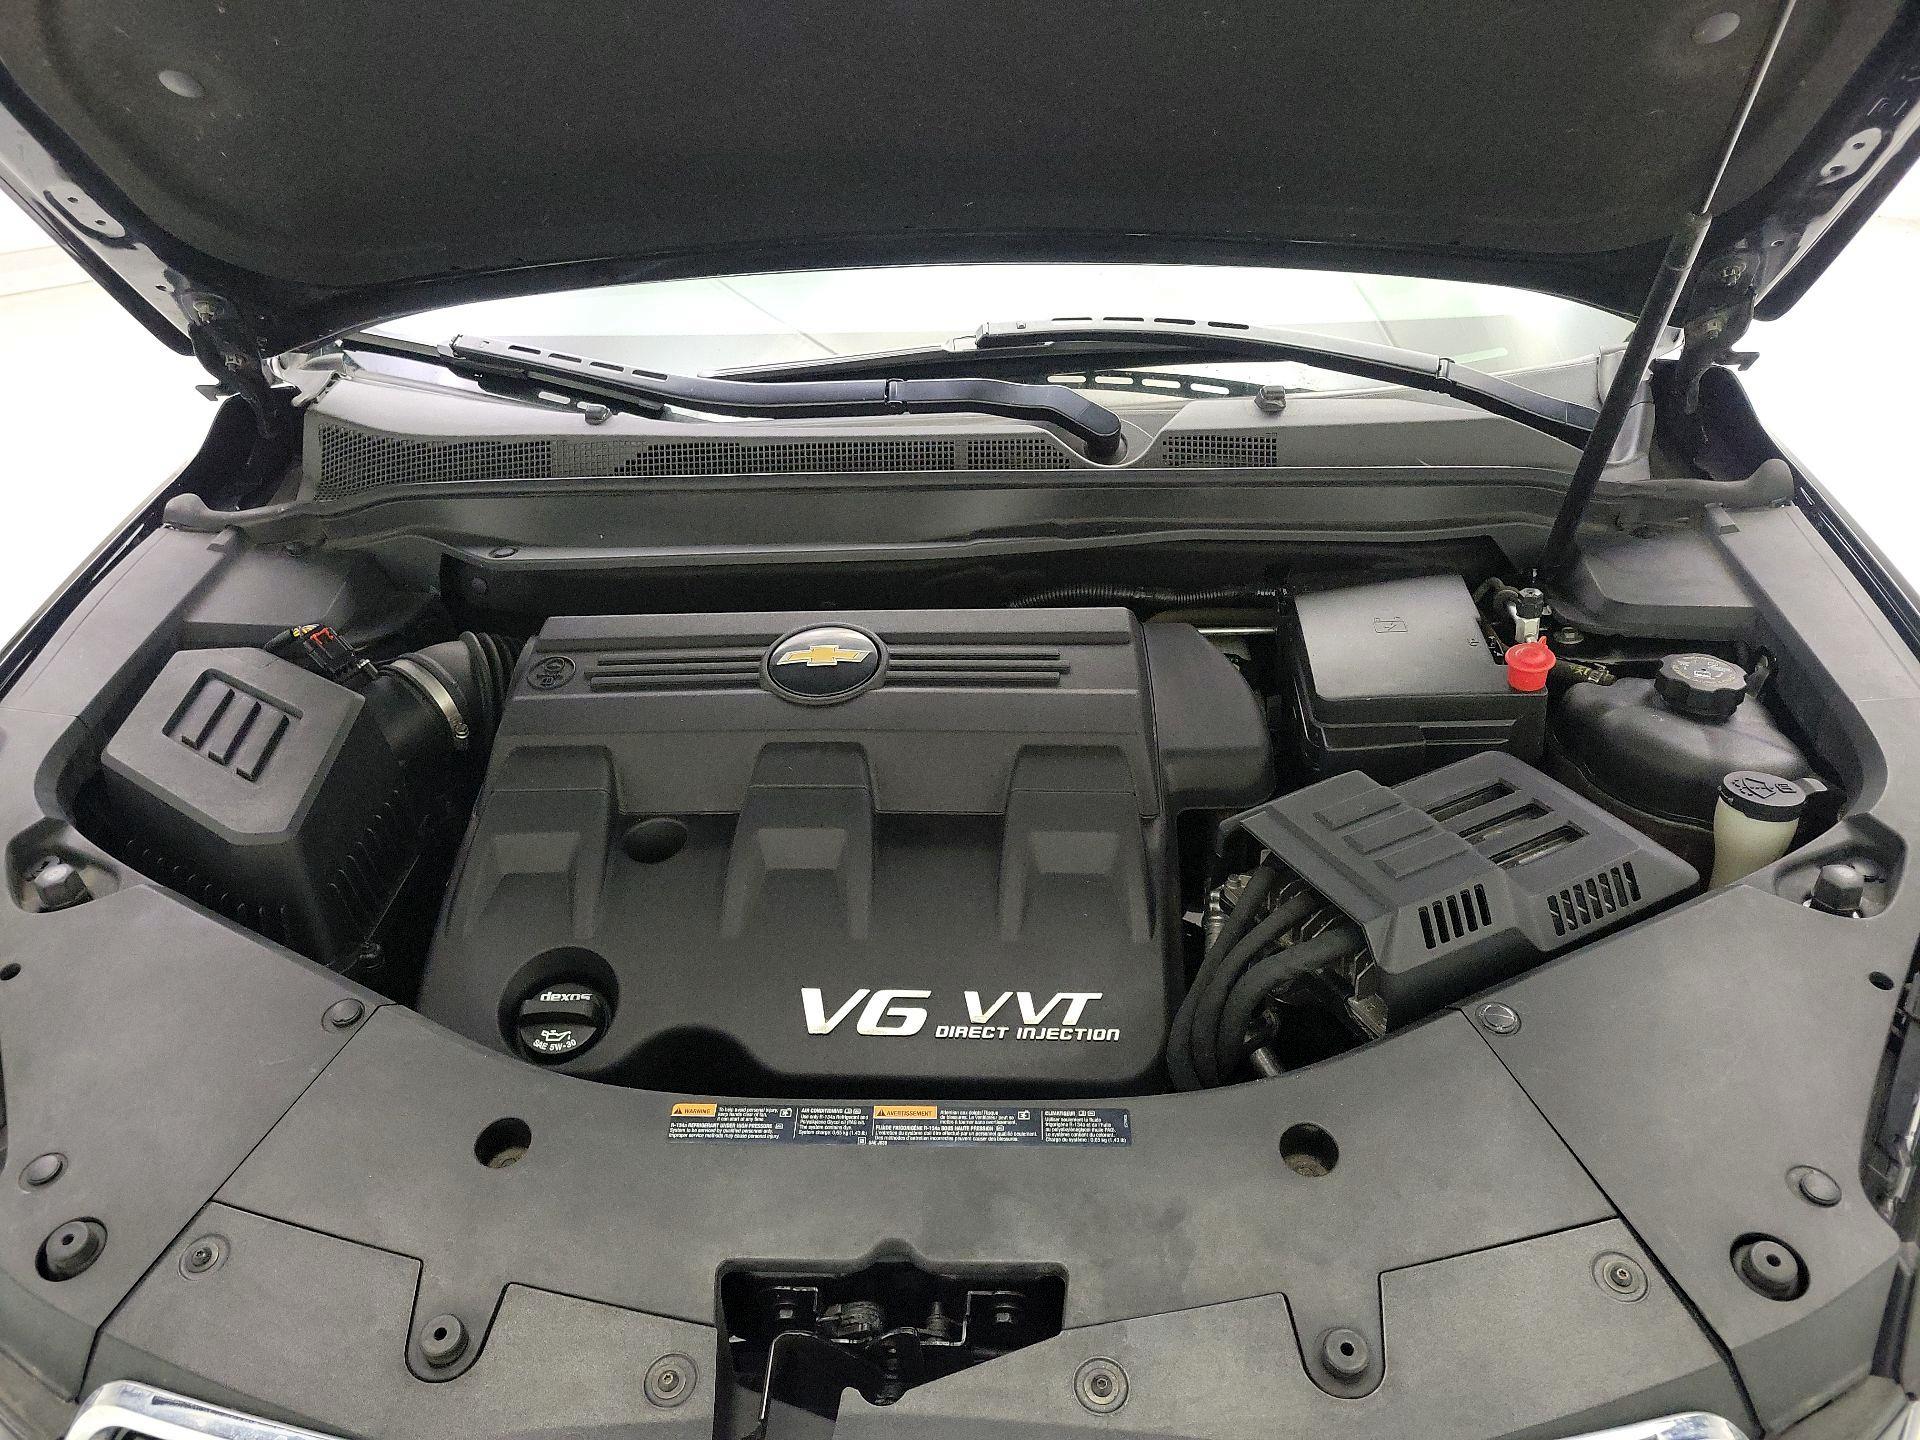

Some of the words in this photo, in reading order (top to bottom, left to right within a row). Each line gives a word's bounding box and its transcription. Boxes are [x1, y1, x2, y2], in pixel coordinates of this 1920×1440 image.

[801, 988, 931, 1036] V6
[964, 991, 1103, 1025] VVT
[935, 1025, 1009, 1040] DIRECT
[1016, 1026, 1121, 1042] INJECTION
[532, 1039, 548, 1051] SAE
[549, 1039, 577, 1051] 5W-30
